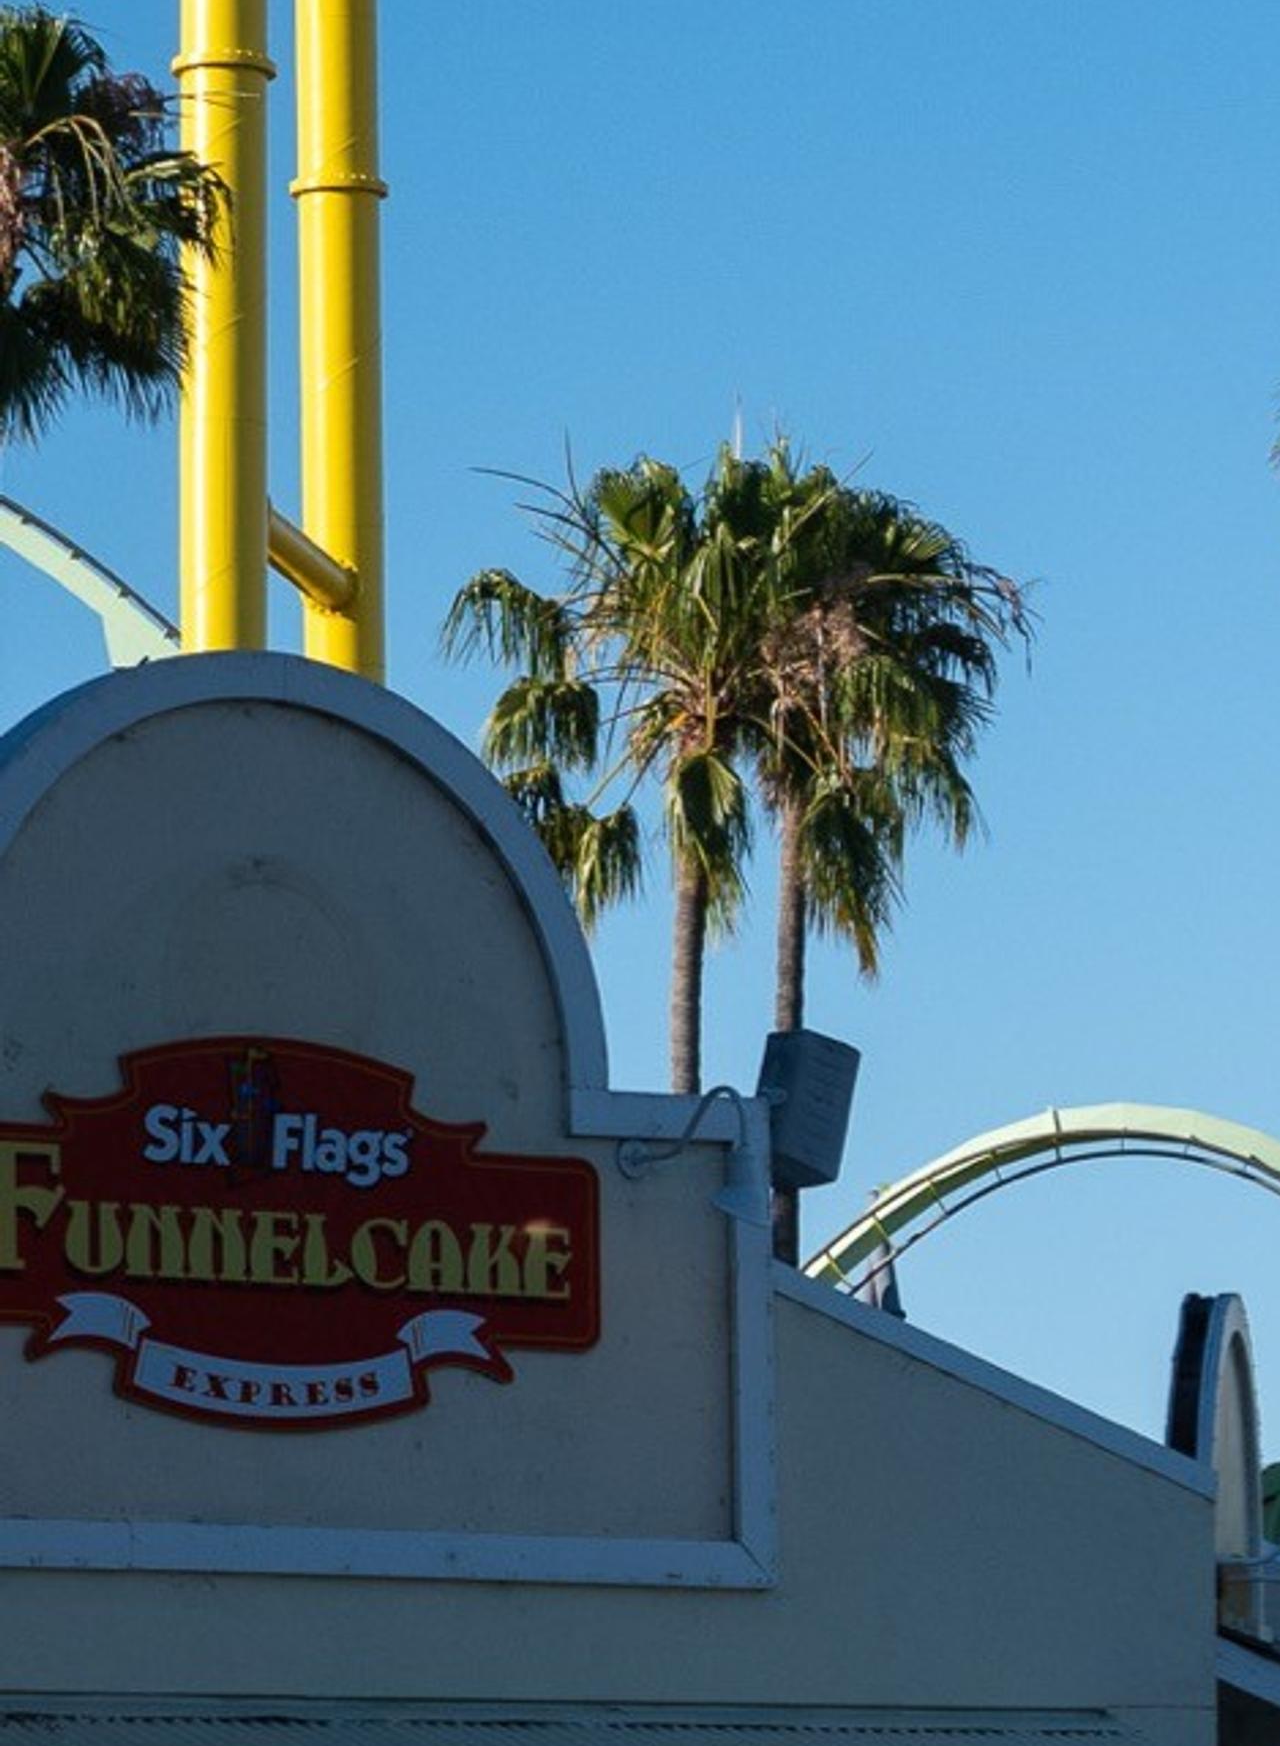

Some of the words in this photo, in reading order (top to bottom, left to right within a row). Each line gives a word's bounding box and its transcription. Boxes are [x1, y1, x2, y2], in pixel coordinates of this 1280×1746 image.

[142, 1103, 231, 1166] Six
[271, 1112, 411, 1188] Flags
[168, 1363, 380, 1407] EXPRESS
